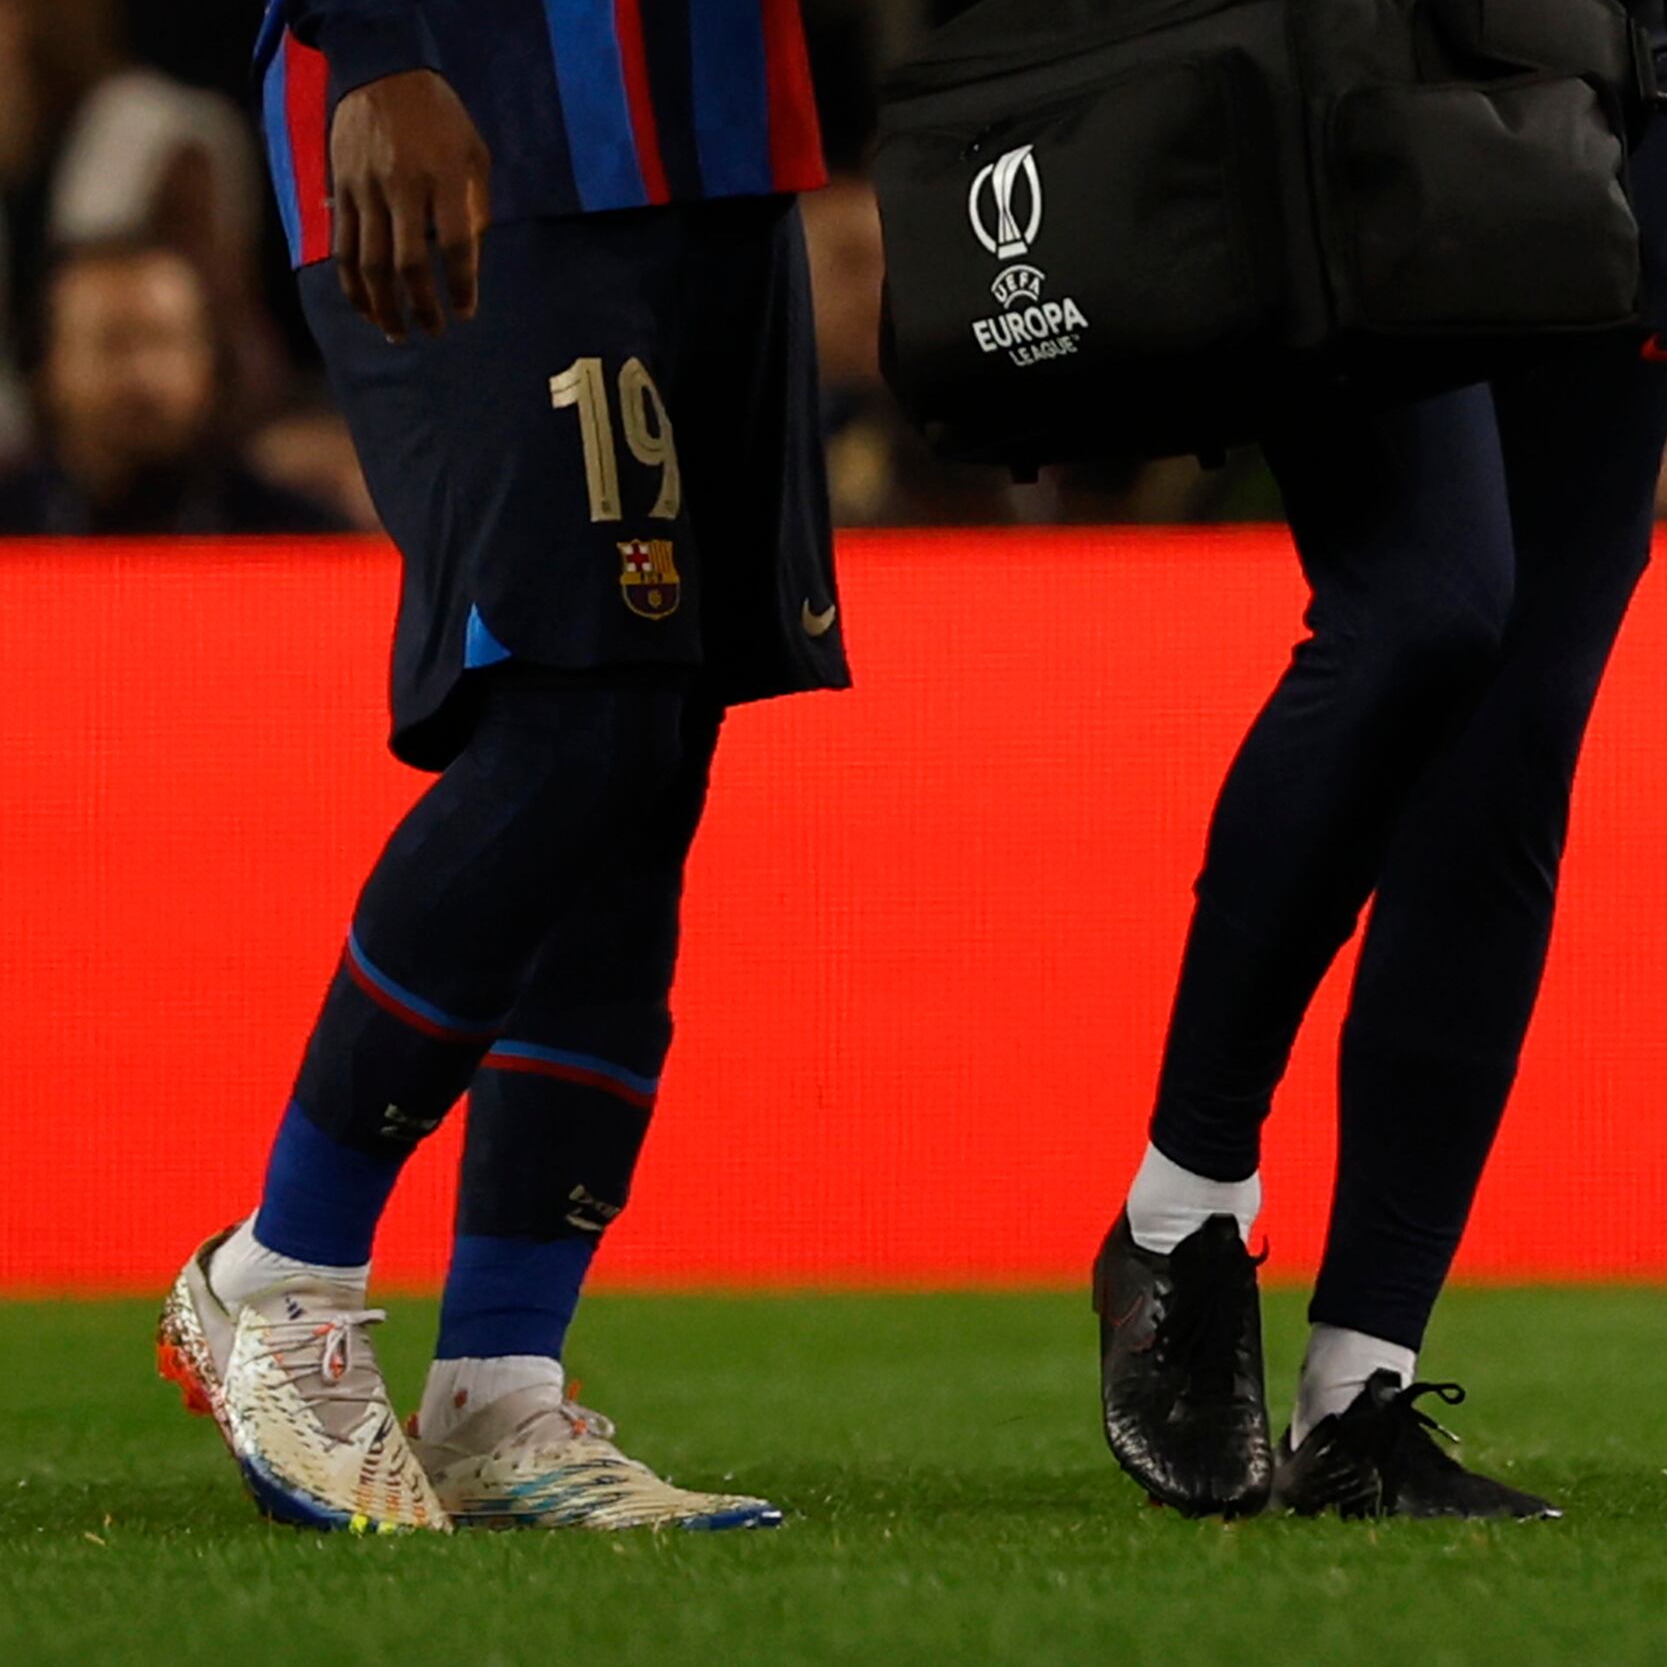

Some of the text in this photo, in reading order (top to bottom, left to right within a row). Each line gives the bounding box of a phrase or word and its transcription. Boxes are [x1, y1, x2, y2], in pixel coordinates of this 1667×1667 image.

[994, 271, 1040, 303] UEFA
[972, 297, 1089, 352] EUROPA
[1008, 335, 1079, 366] LEAGUE
[549, 356, 682, 523] 19
